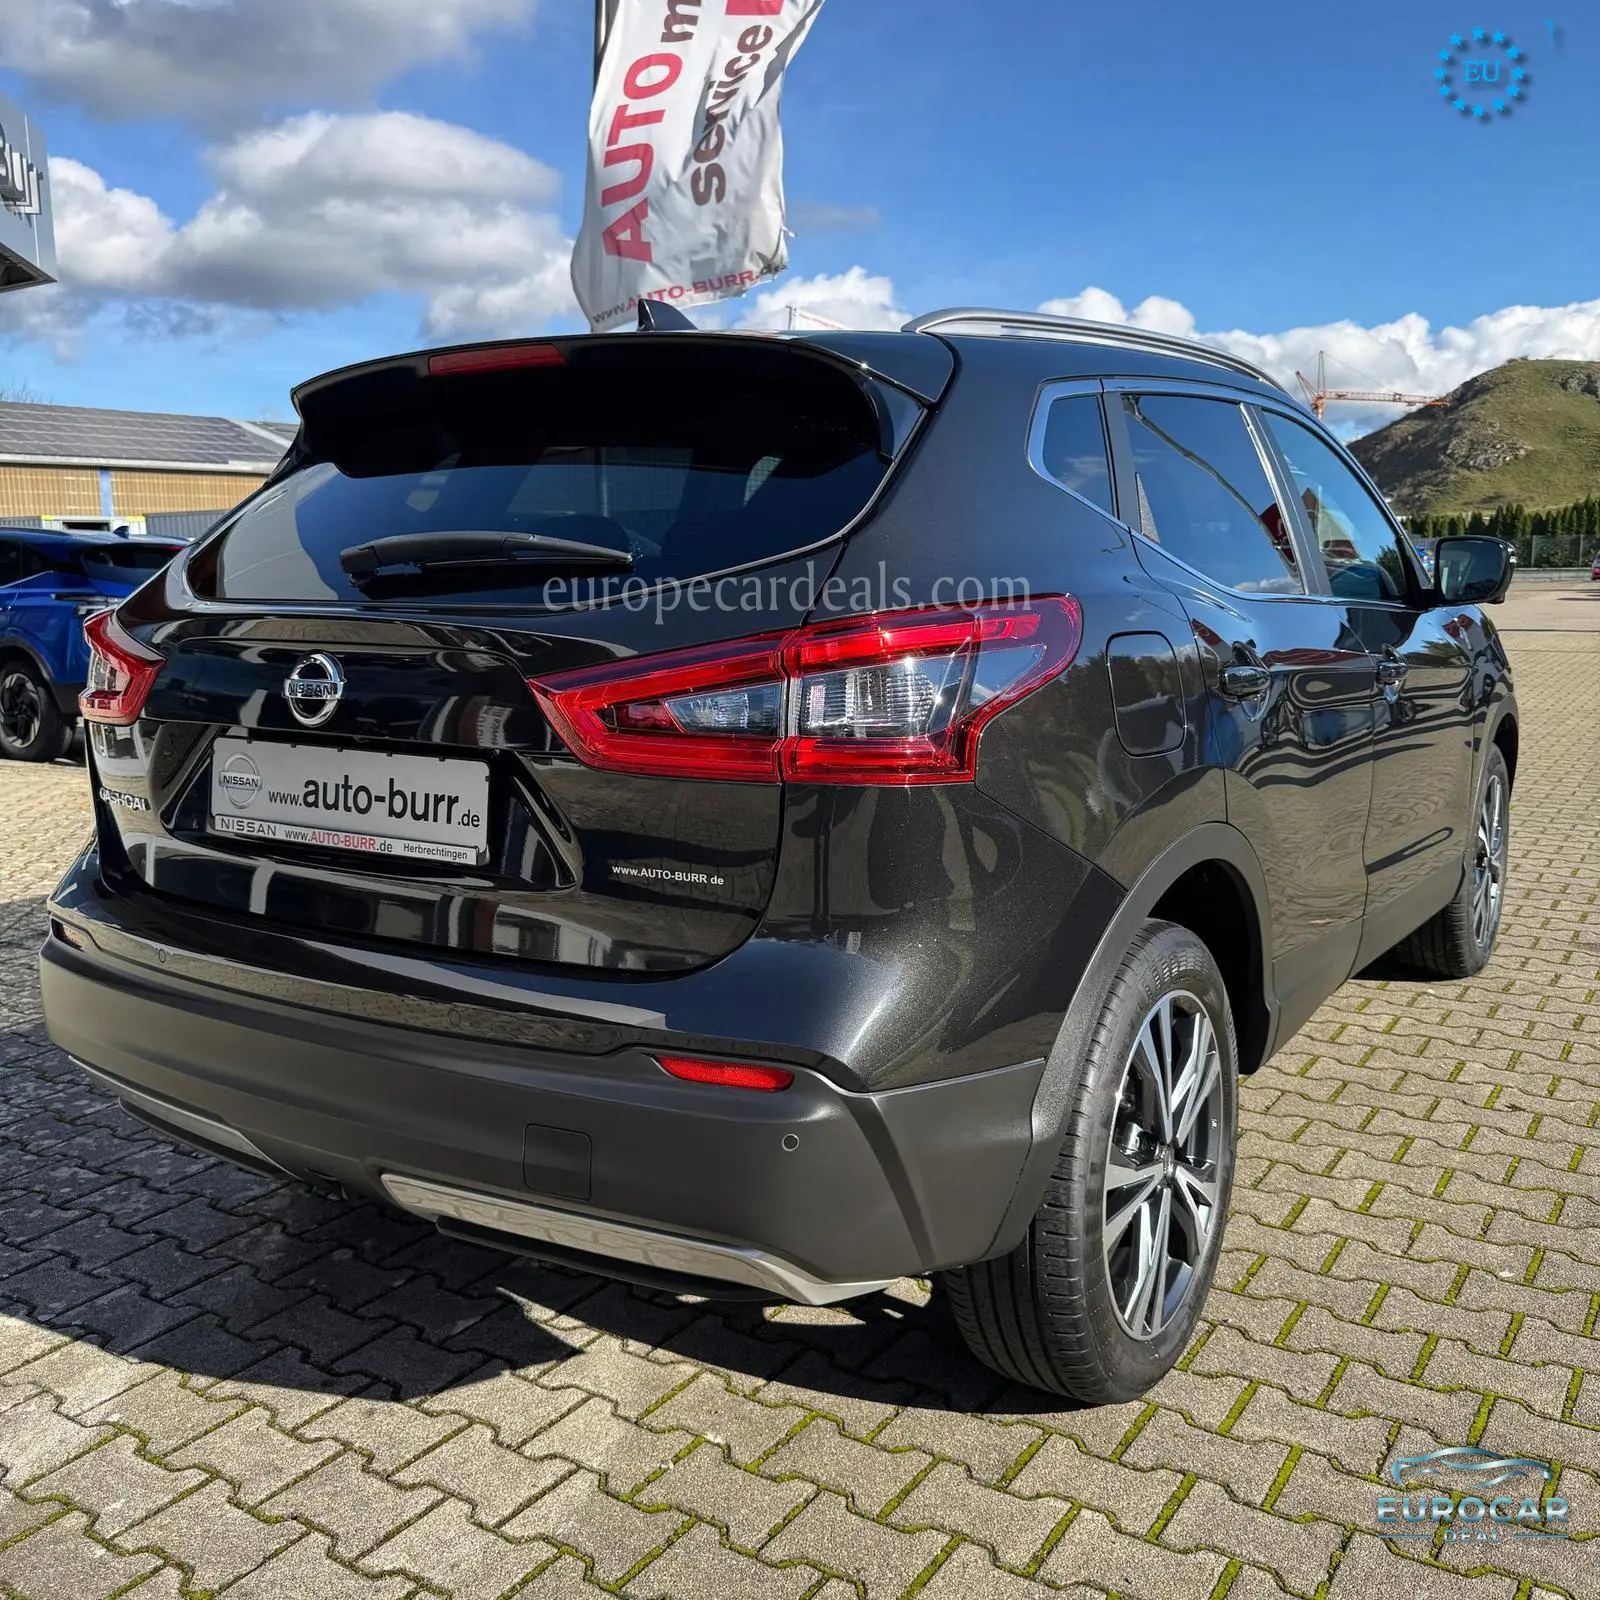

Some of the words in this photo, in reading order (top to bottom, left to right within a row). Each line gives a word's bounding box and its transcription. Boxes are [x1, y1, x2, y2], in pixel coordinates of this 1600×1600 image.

[691, 24, 773, 206] service
[601, 53, 683, 263] AUTO
[288, 682, 335, 698] NISSAN
[222, 774, 260, 789] NISSAN
[268, 774, 481, 828] www.auto-burr.de
[220, 816, 277, 837] NISSAN
[284, 828, 393, 854] www.AUTO-BURR.de
[402, 841, 468, 861] Herbrechtingen
